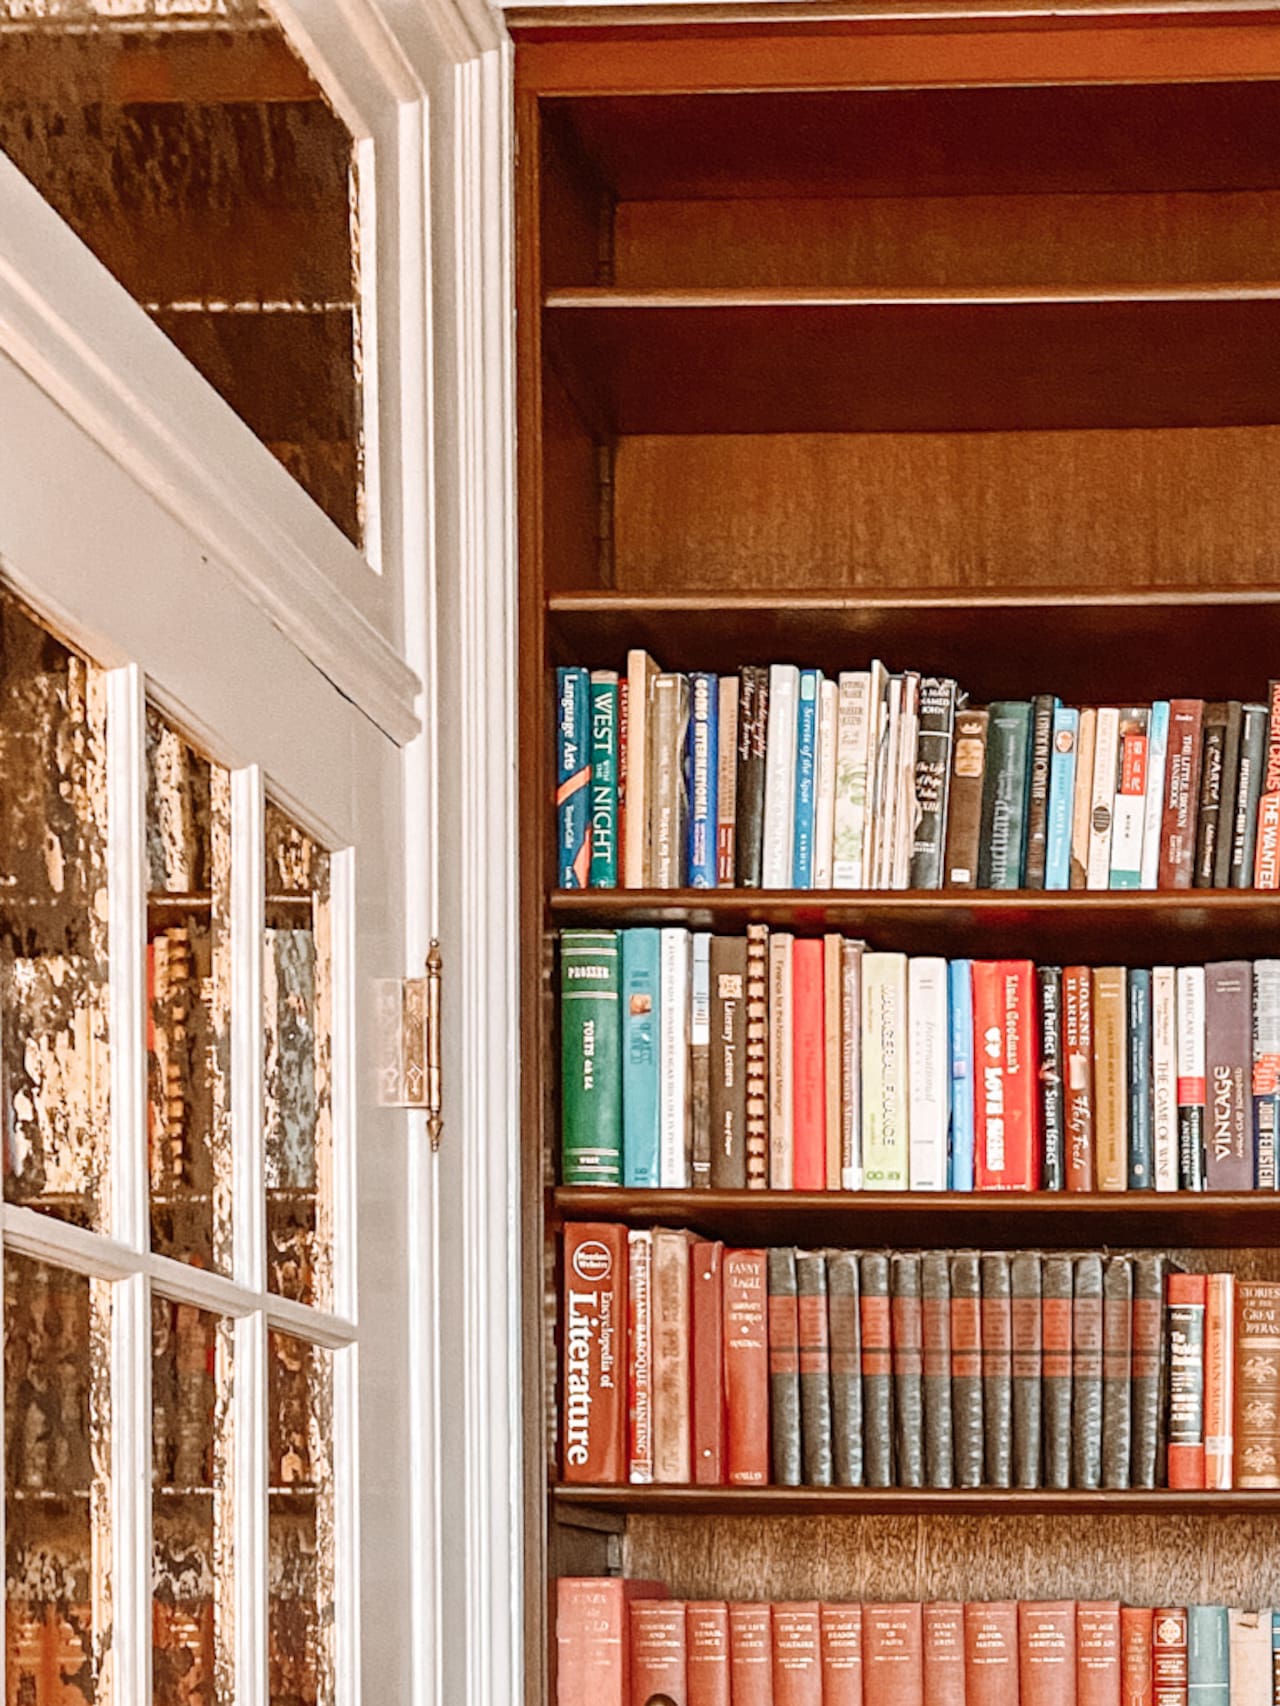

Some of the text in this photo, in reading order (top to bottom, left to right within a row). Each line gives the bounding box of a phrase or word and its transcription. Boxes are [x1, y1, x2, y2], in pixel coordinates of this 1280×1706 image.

[562, 674, 578, 771] Language Arts
[594, 692, 612, 755] WEST
[694, 679, 708, 821] GOING INTERNATIONAL
[800, 707, 813, 775] Secrets of the
[1056, 800, 1066, 835] TRAVEL
[1170, 754, 1181, 809] HANDBOOK
[1177, 735, 1192, 828] THE BROWN
[1265, 797, 1280, 824] THE
[593, 787, 612, 863] NIGHT
[583, 1020, 594, 1055] TORTS
[723, 1001, 736, 1087] Literary Lectures
[774, 960, 784, 1116] Finance for the Nonfinancial Manager
[1006, 974, 1020, 1074] Linda Goodman's
[1067, 977, 1078, 1046] HARRIS
[1078, 977, 1090, 1046] JOANNE
[1185, 975, 1194, 1072] AMERICAN EVITA
[881, 984, 896, 1145] MANAGERIAL FINANCE
[923, 1020, 936, 1103] International
[985, 1067, 1003, 1114] LOVE
[1043, 985, 1057, 1165] Past Perfect Susan Isaacs
[1157, 1061, 1169, 1178] THE GAME OF WINE
[1182, 1120, 1191, 1173] ANDERSEN
[1212, 1066, 1230, 1161] VINTAGE
[1259, 1102, 1274, 1188] JOHN FEINSTEIN
[1239, 1287, 1280, 1298] STORIES
[1240, 1321, 1280, 1334] OPERAS
[1242, 1308, 1275, 1321] GREAT
[567, 1290, 598, 1466] Literature
[599, 1291, 614, 1387] Encyclopedia of
[636, 1266, 647, 1454] ITALIAN BAROQUE PAINTING
[1212, 1317, 1221, 1429] RUSSIAN MUSIC
[1082, 1623, 1113, 1631] THE AGE
